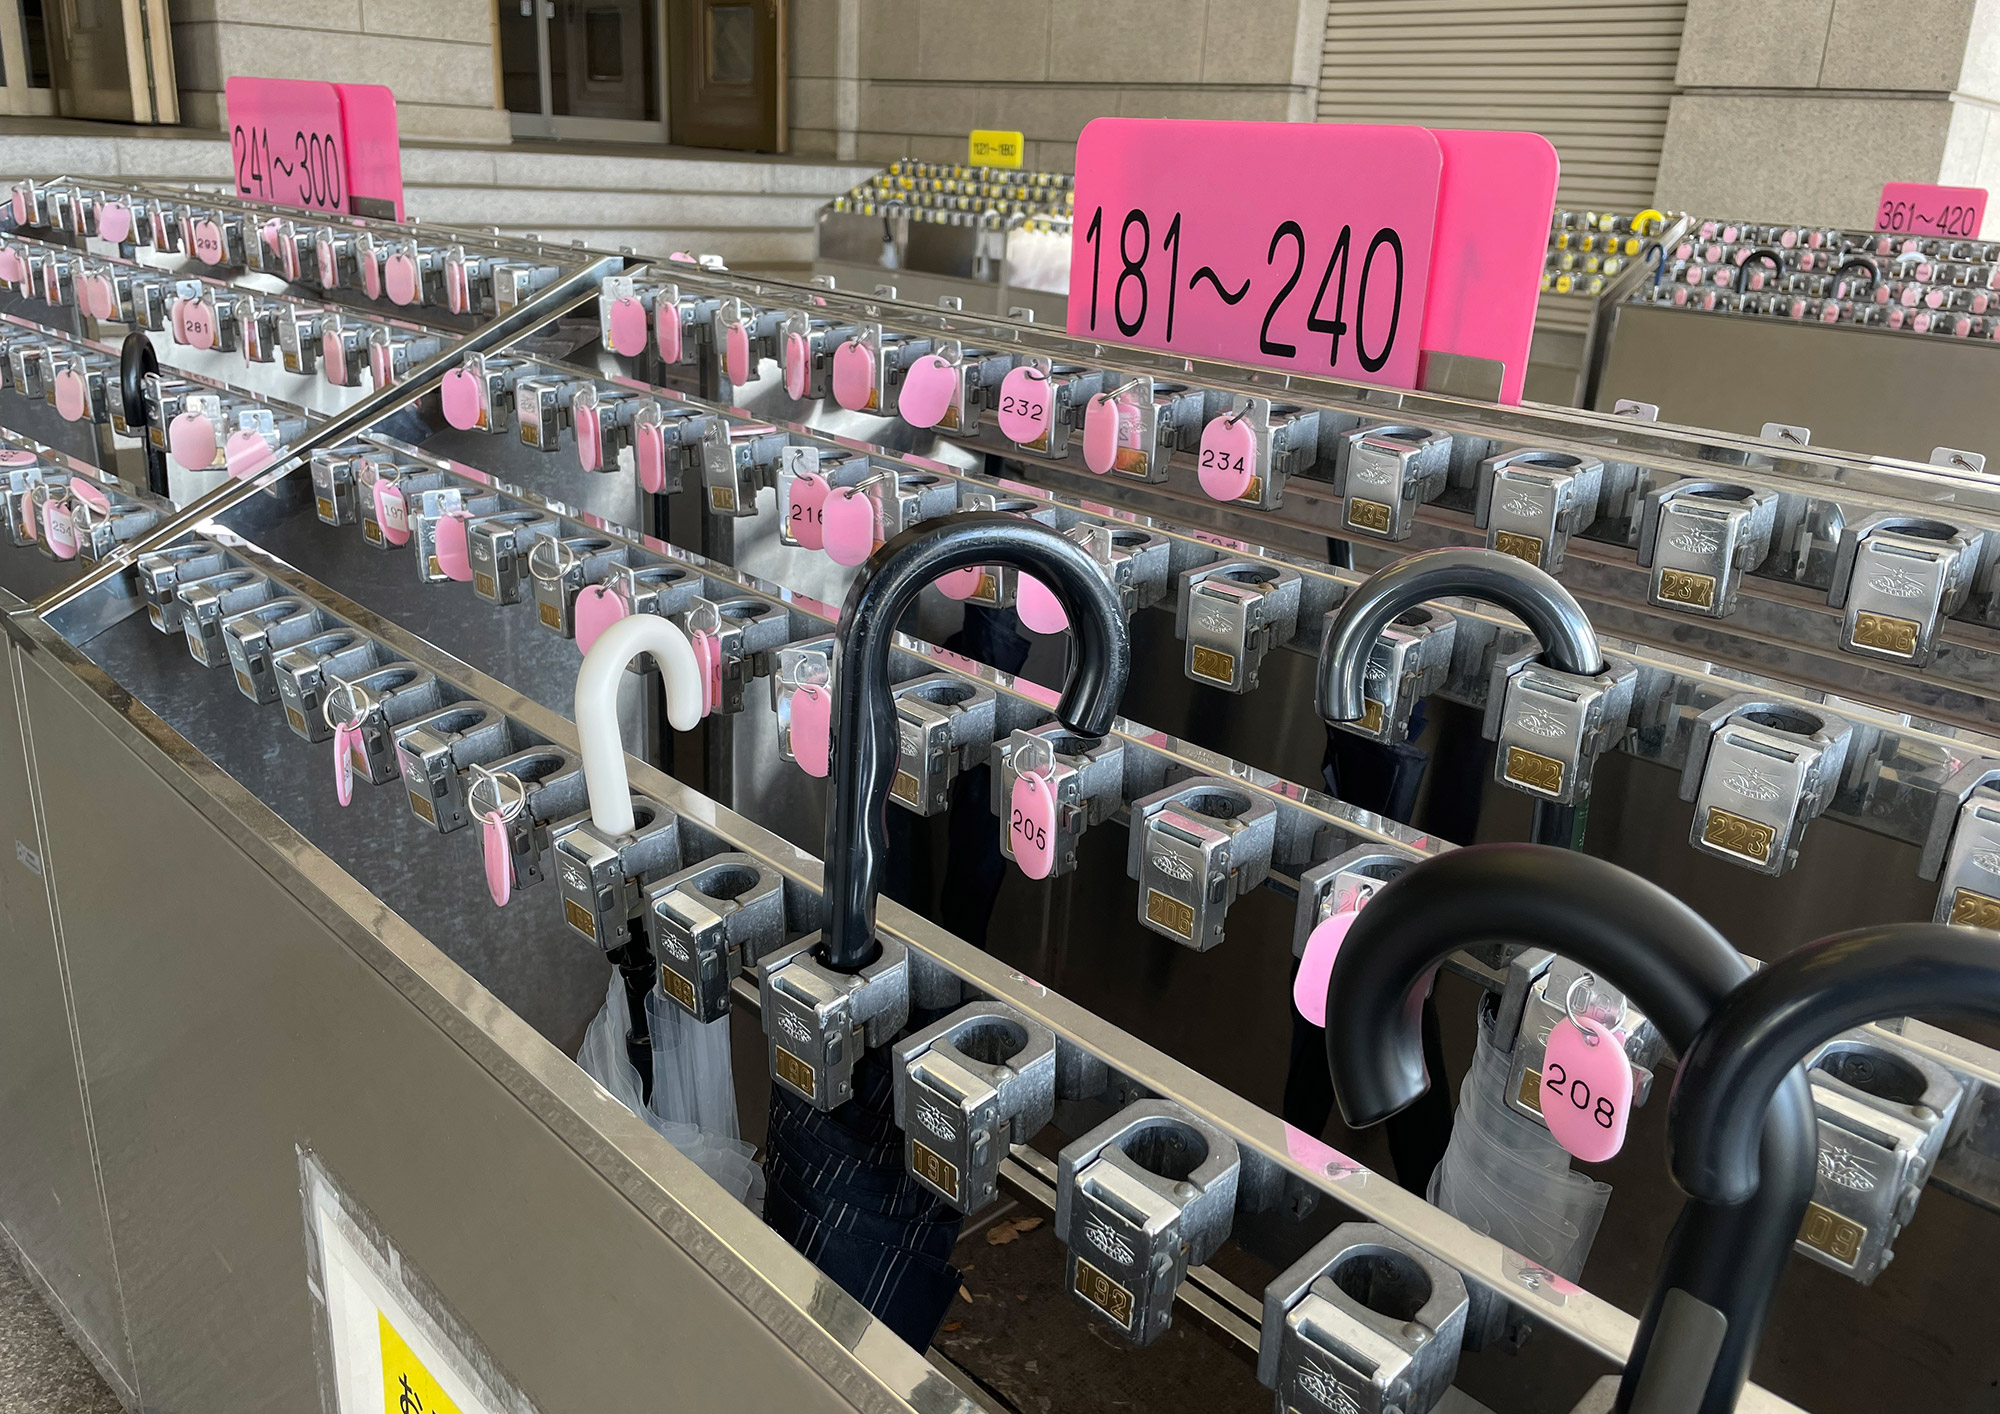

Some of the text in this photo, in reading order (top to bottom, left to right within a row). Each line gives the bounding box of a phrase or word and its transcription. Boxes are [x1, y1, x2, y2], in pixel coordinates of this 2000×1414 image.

[197, 238, 218, 250] 293
[186, 321, 209, 334] 281
[1002, 396, 1044, 421] 232
[1202, 449, 1245, 474] 234
[52, 520, 73, 537] 254
[384, 504, 404, 521] 197
[1350, 498, 1389, 531] 235
[1499, 532, 1540, 563] 236
[1661, 574, 1714, 604] 237
[1857, 618, 1915, 650] 238
[1195, 651, 1231, 679] 220
[1510, 753, 1560, 789] 222
[894, 774, 917, 802] 04
[1012, 808, 1047, 851] 205
[1708, 814, 1769, 856] 223
[1151, 895, 1192, 934] 206
[1955, 897, 2000, 930] 22
[779, 1054, 812, 1092] 190
[1546, 1063, 1615, 1129] 208
[916, 1146, 951, 1192] 191
[1806, 1211, 1858, 1259] 09
[1081, 1265, 1129, 1319] 192
